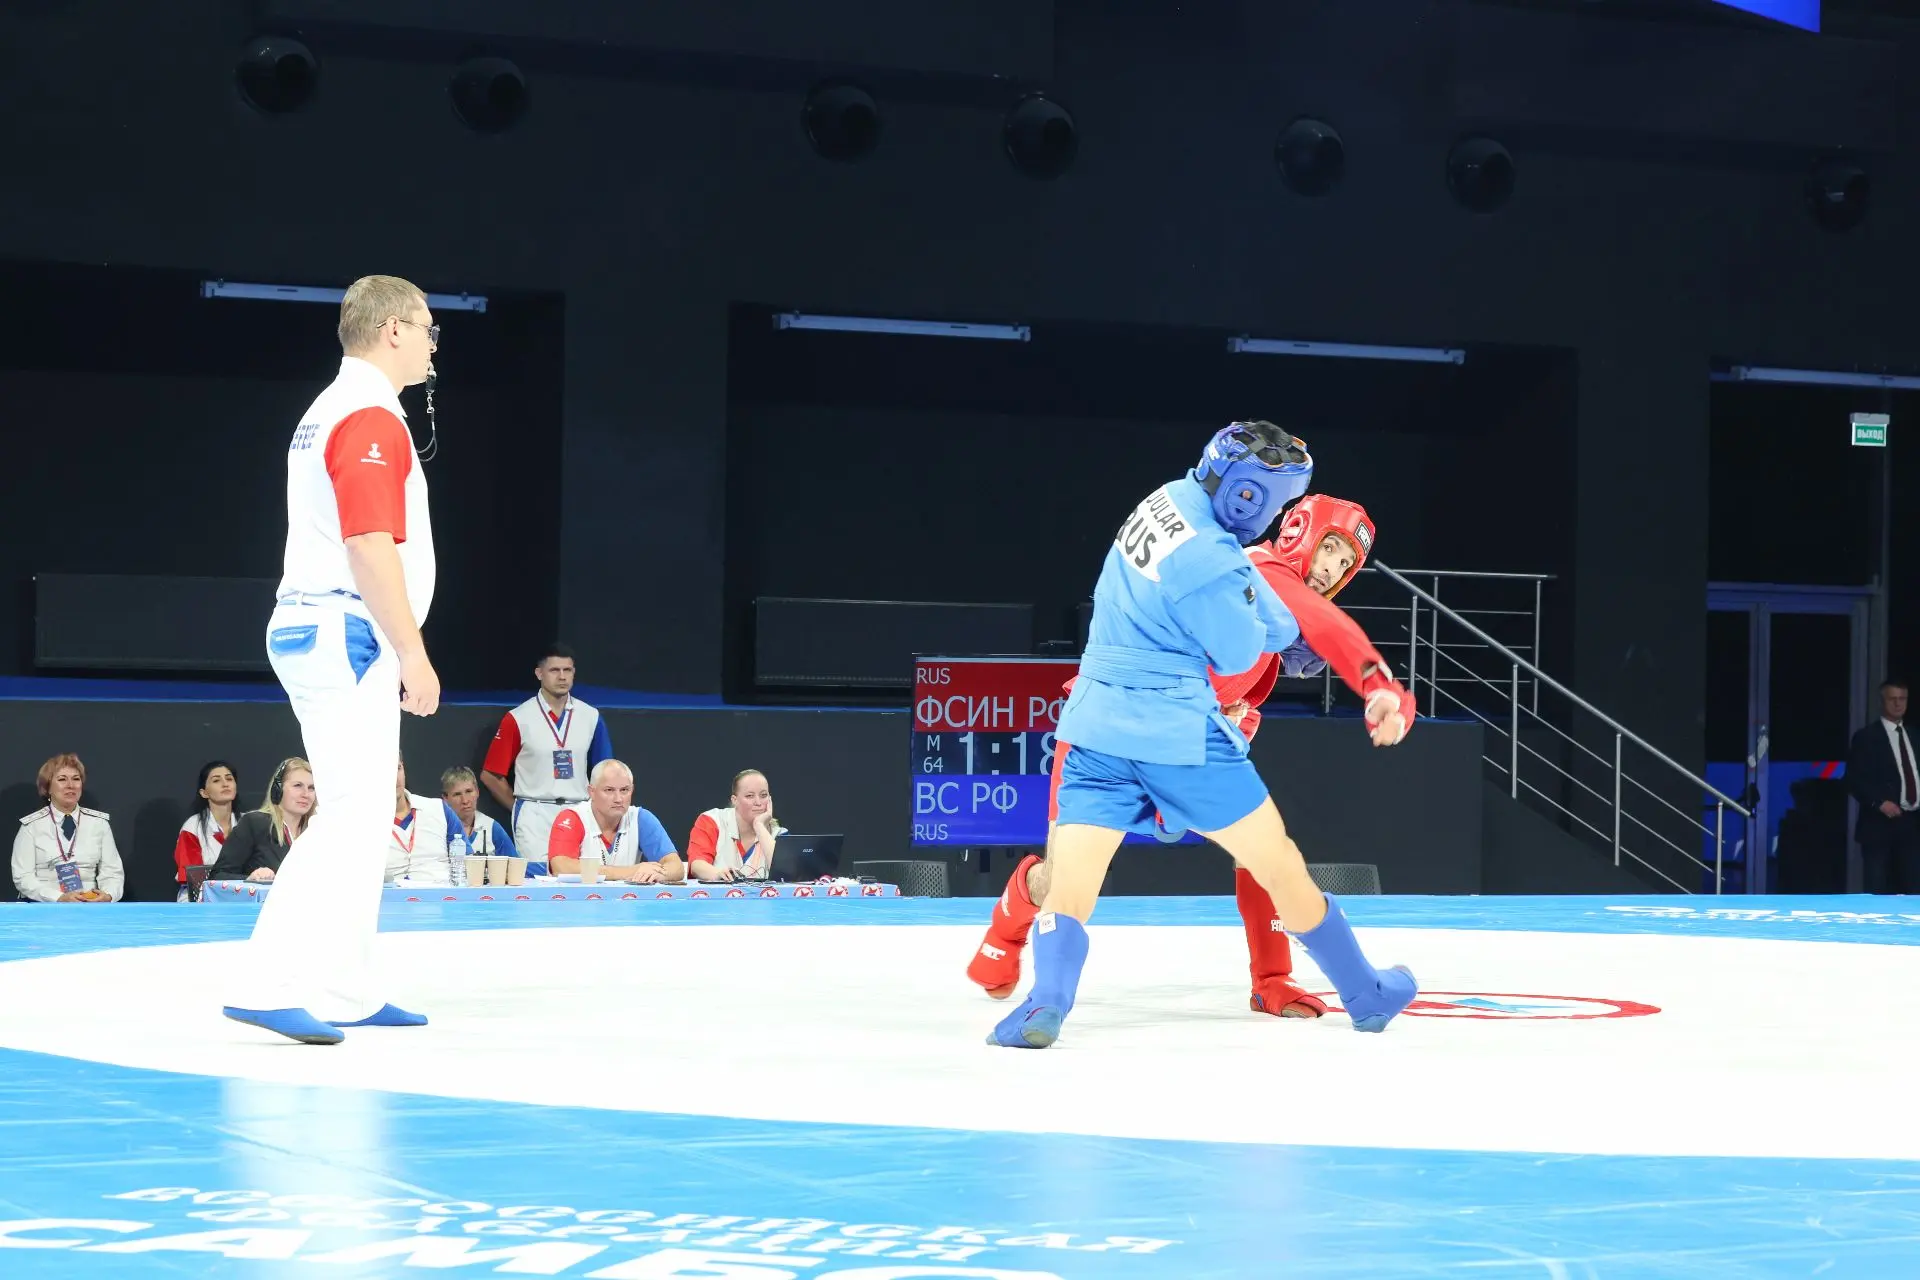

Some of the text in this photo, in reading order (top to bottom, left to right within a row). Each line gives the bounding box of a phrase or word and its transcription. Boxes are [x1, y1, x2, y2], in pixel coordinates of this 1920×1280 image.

[1857, 429, 1883, 440] ВЫХОД
[1115, 507, 1157, 569] RUS
[916, 668, 950, 684] RUS
[916, 694, 1014, 728] ФСИН
[923, 757, 943, 773] 64
[916, 781, 1018, 814] ВС РФ
[914, 824, 948, 841] RUS
